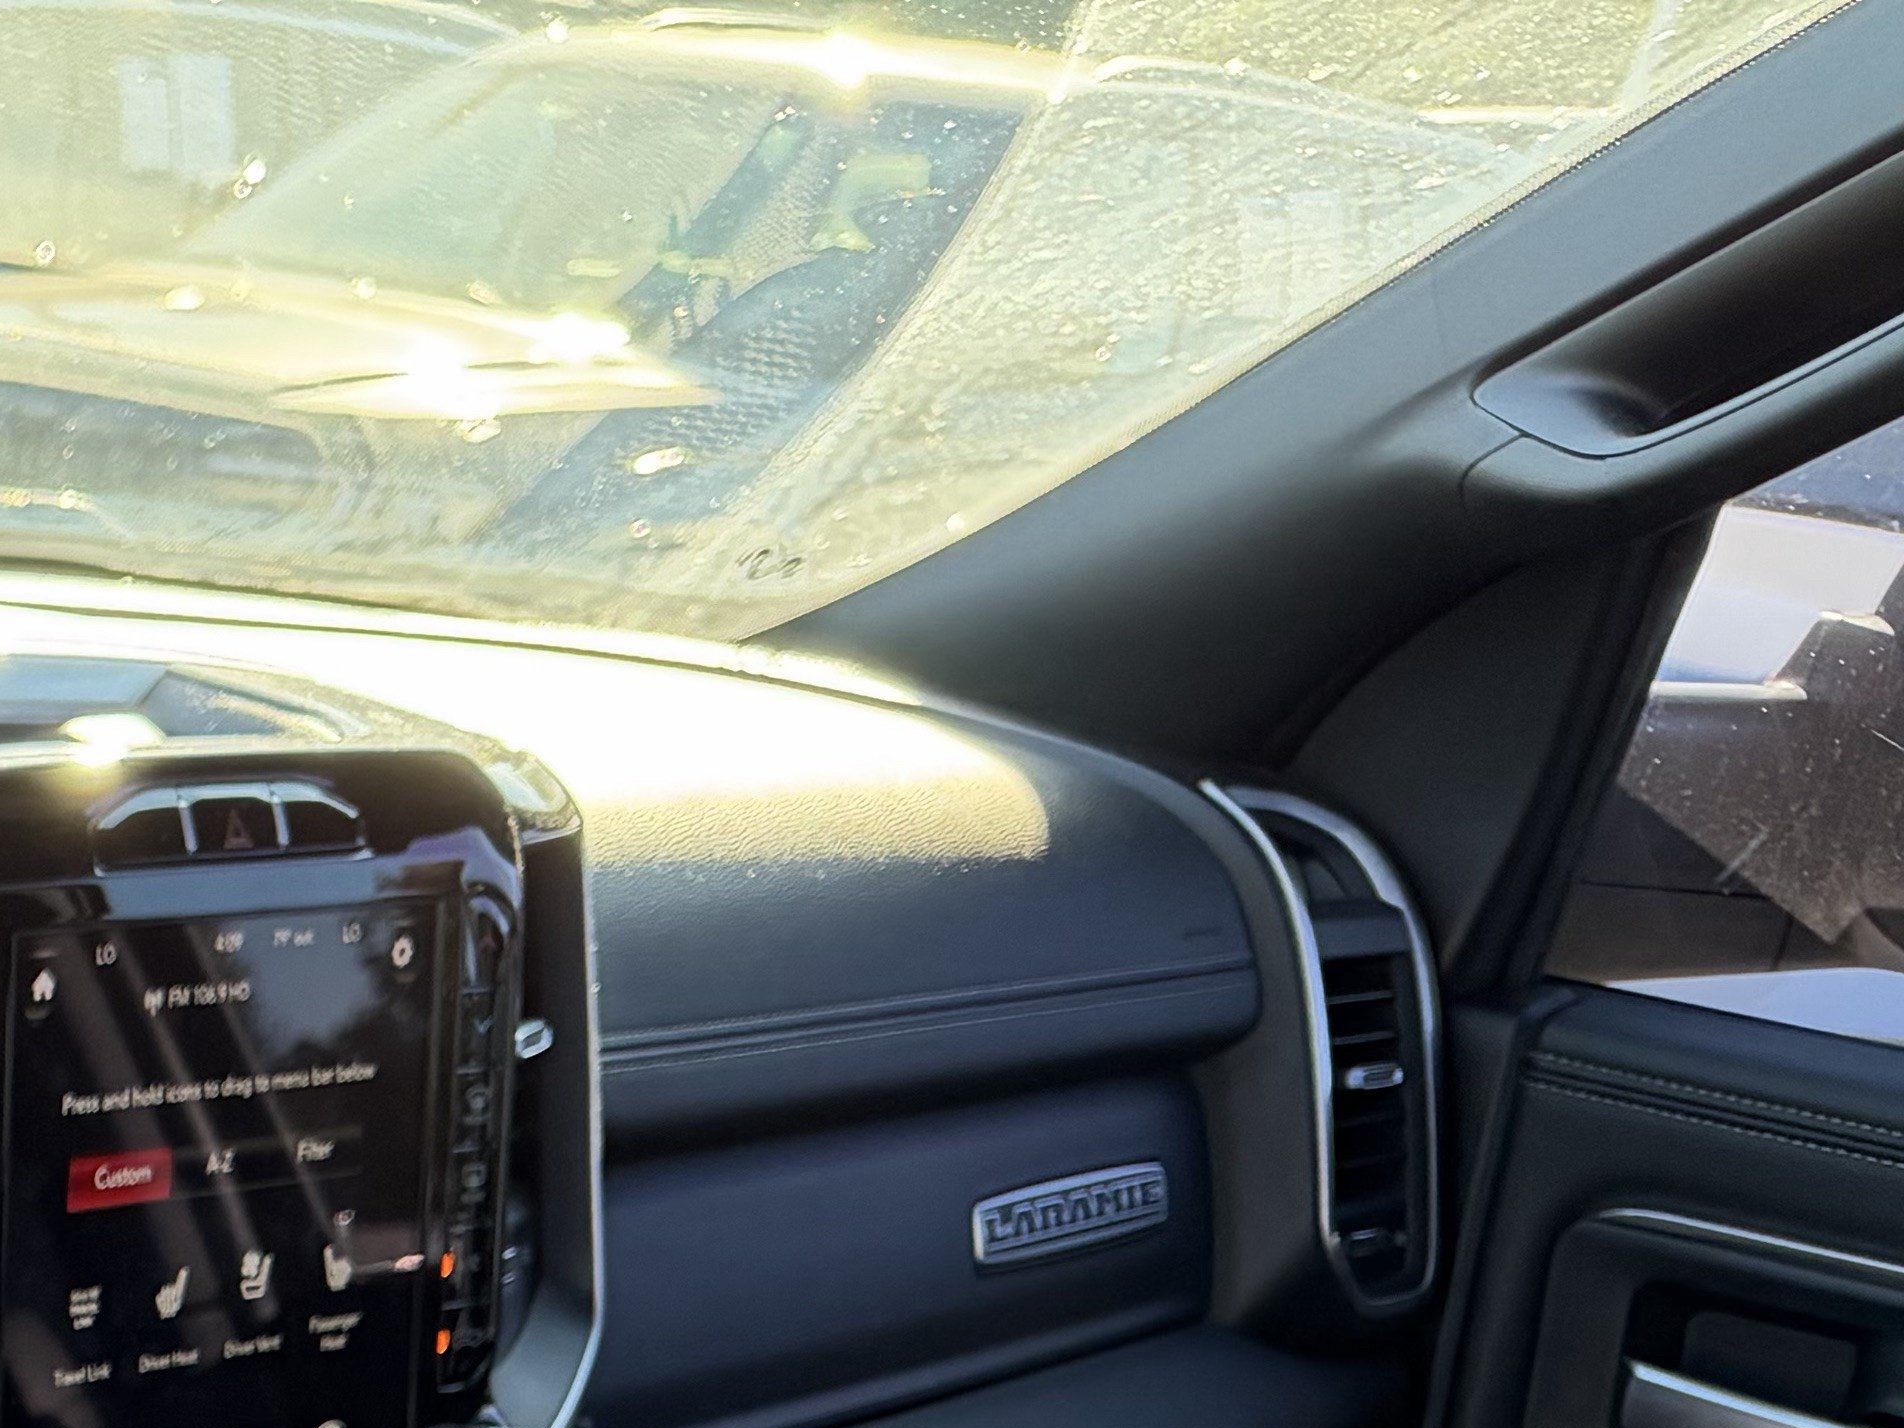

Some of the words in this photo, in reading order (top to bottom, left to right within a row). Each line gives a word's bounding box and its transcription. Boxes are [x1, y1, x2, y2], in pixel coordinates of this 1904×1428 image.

[61, 1091, 100, 1117] Press
[101, 1086, 131, 1112] and
[131, 1083, 165, 1107] hold
[204, 1079, 220, 1101] to
[221, 1073, 254, 1100] drag
[254, 1073, 271, 1094] to
[271, 1068, 311, 1090] menu
[311, 1063, 337, 1087] bar
[336, 1060, 380, 1083] below
[93, 1163, 153, 1190] Custom
[984, 1178, 1163, 1243] LARAMIE
